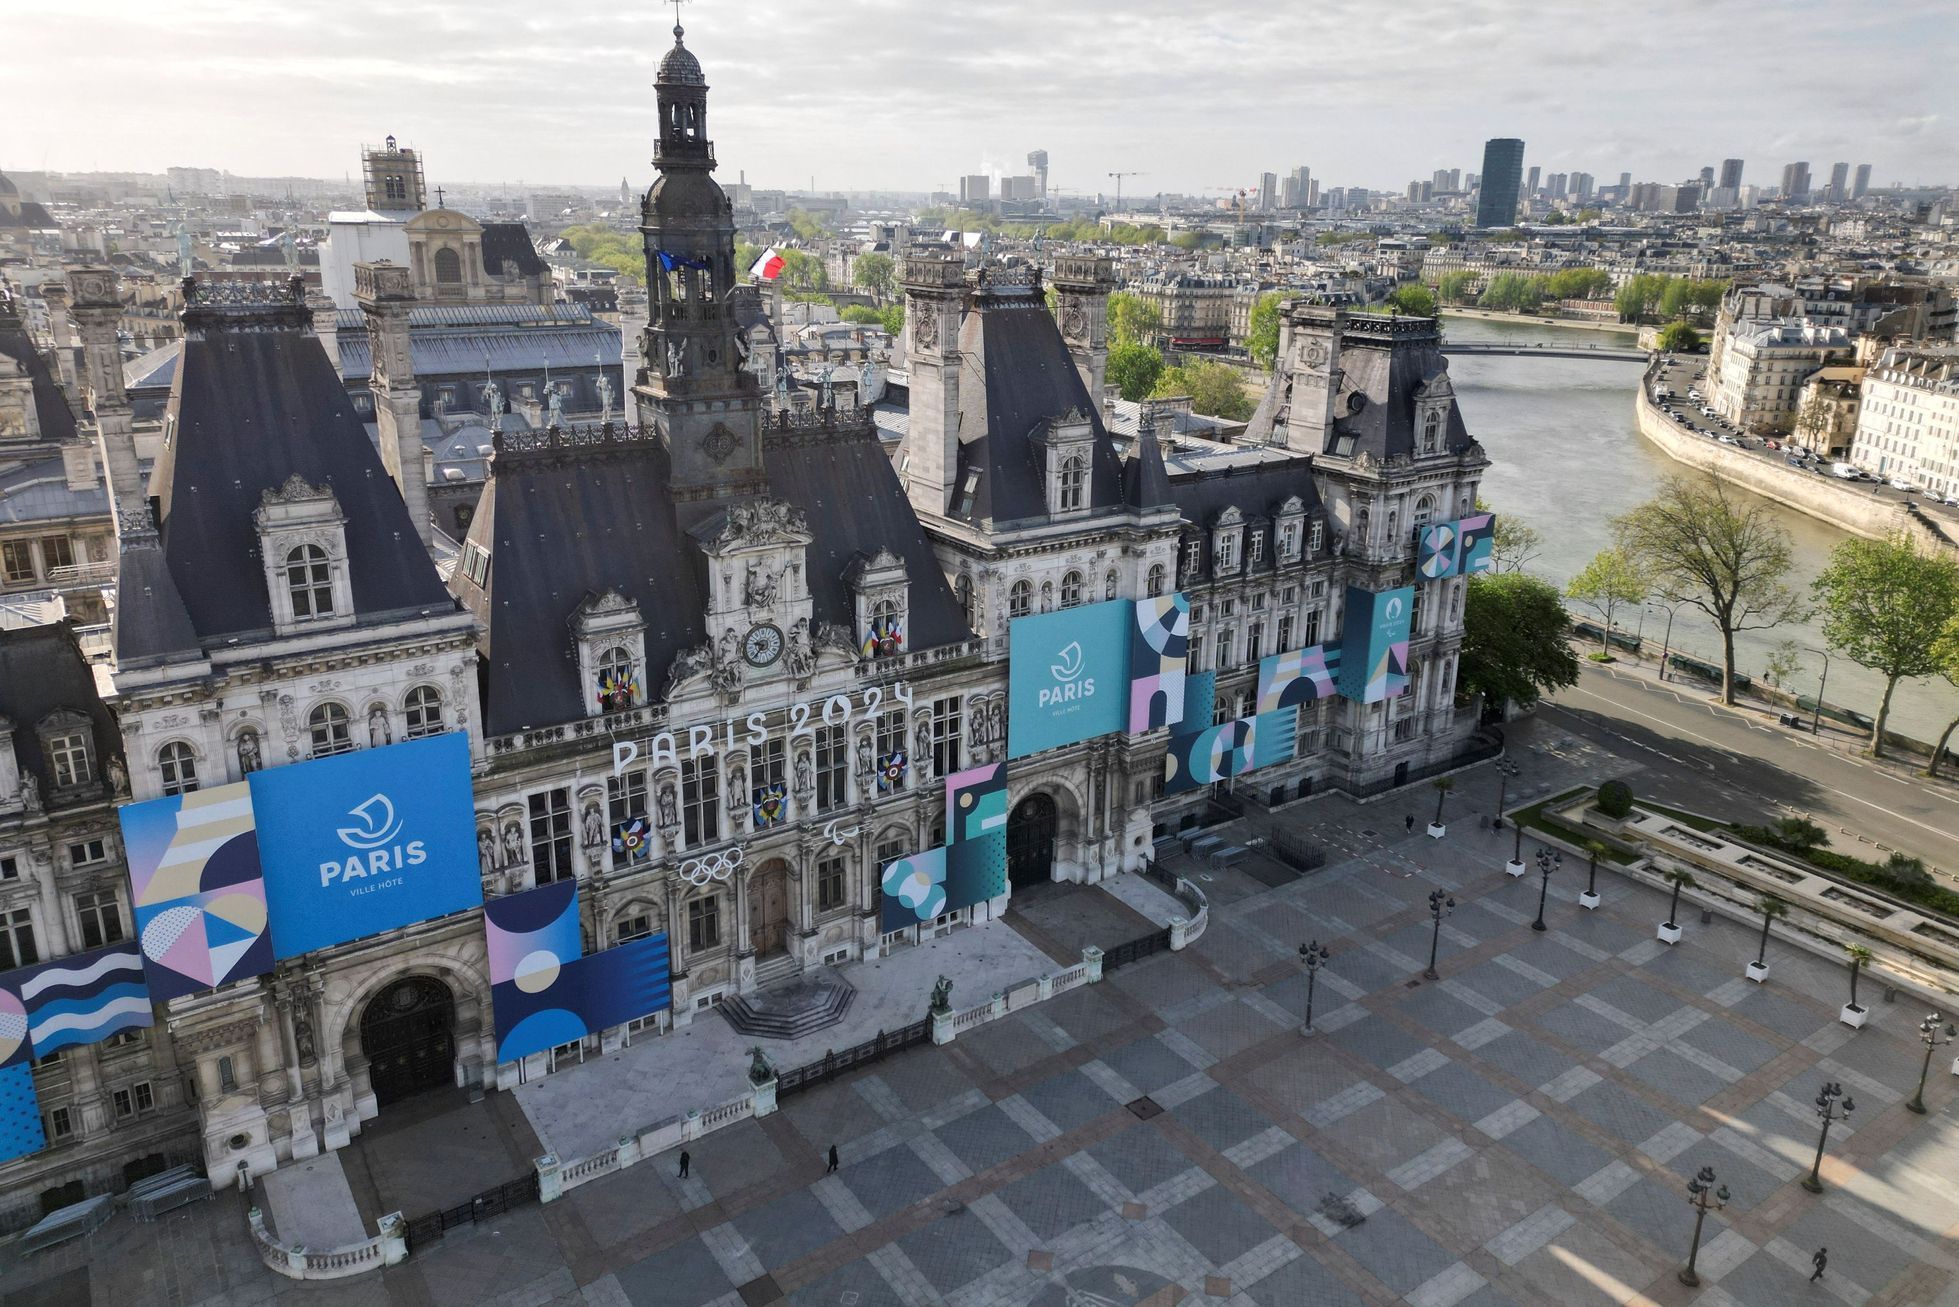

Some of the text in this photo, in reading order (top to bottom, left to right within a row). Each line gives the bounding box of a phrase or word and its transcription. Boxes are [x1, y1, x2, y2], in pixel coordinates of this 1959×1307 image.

[790, 682, 913, 737] 2024
[1039, 678, 1095, 708] PARIS
[319, 840, 427, 888] PARIS
[350, 877, 404, 897] VILLE HÔTE
